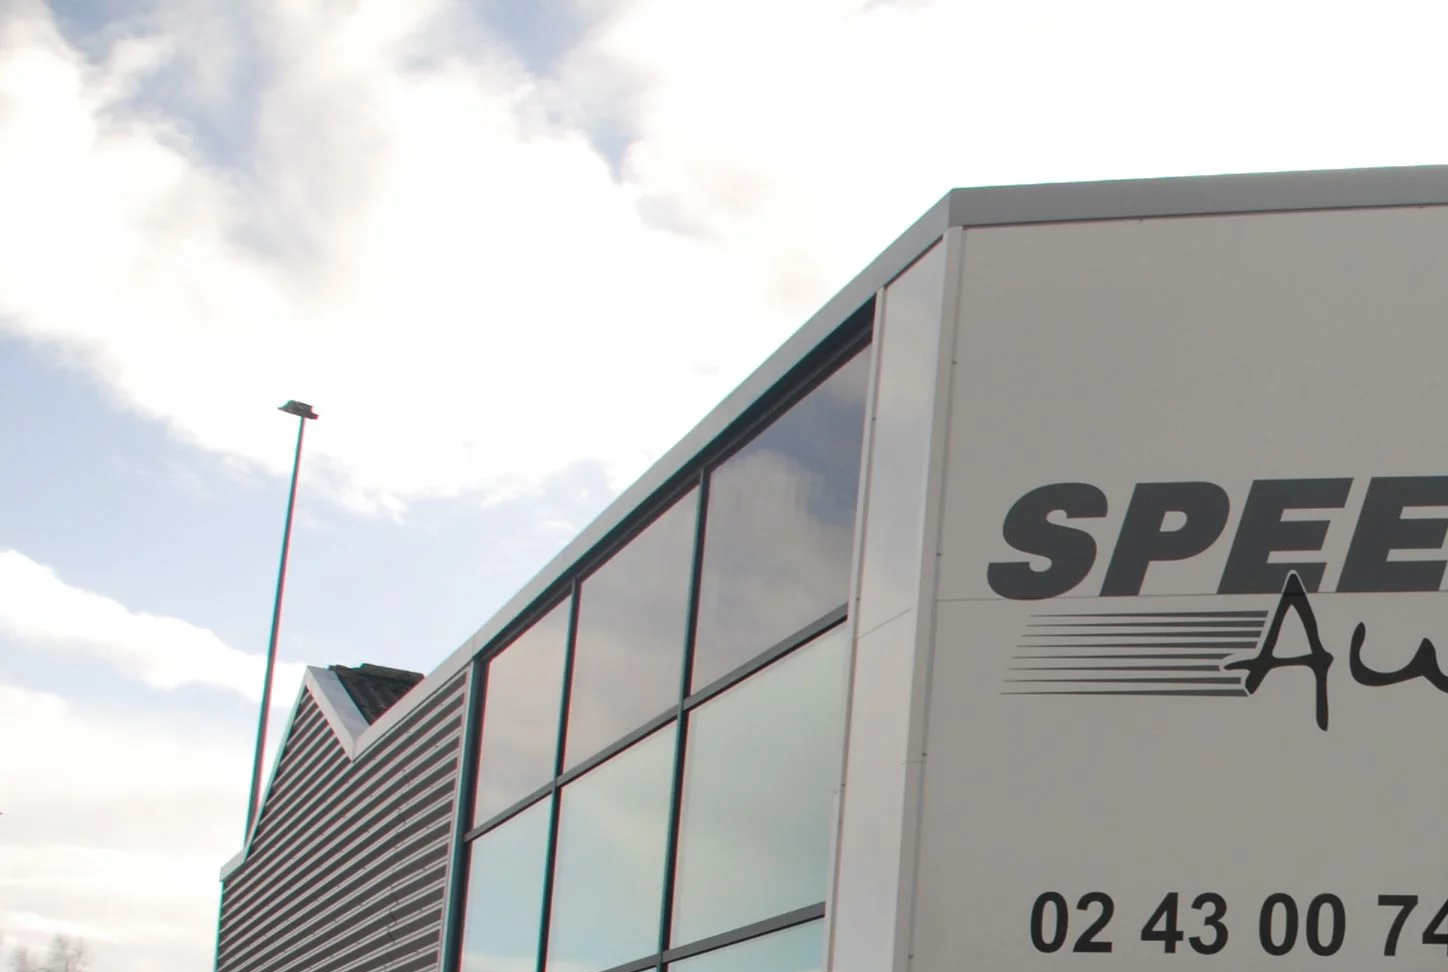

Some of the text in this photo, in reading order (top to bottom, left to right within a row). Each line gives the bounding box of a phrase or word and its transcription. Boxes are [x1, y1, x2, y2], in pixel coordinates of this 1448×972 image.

[1030, 890, 1115, 955] 02
[1141, 891, 1229, 957] 43
[1258, 892, 1346, 958] 00
